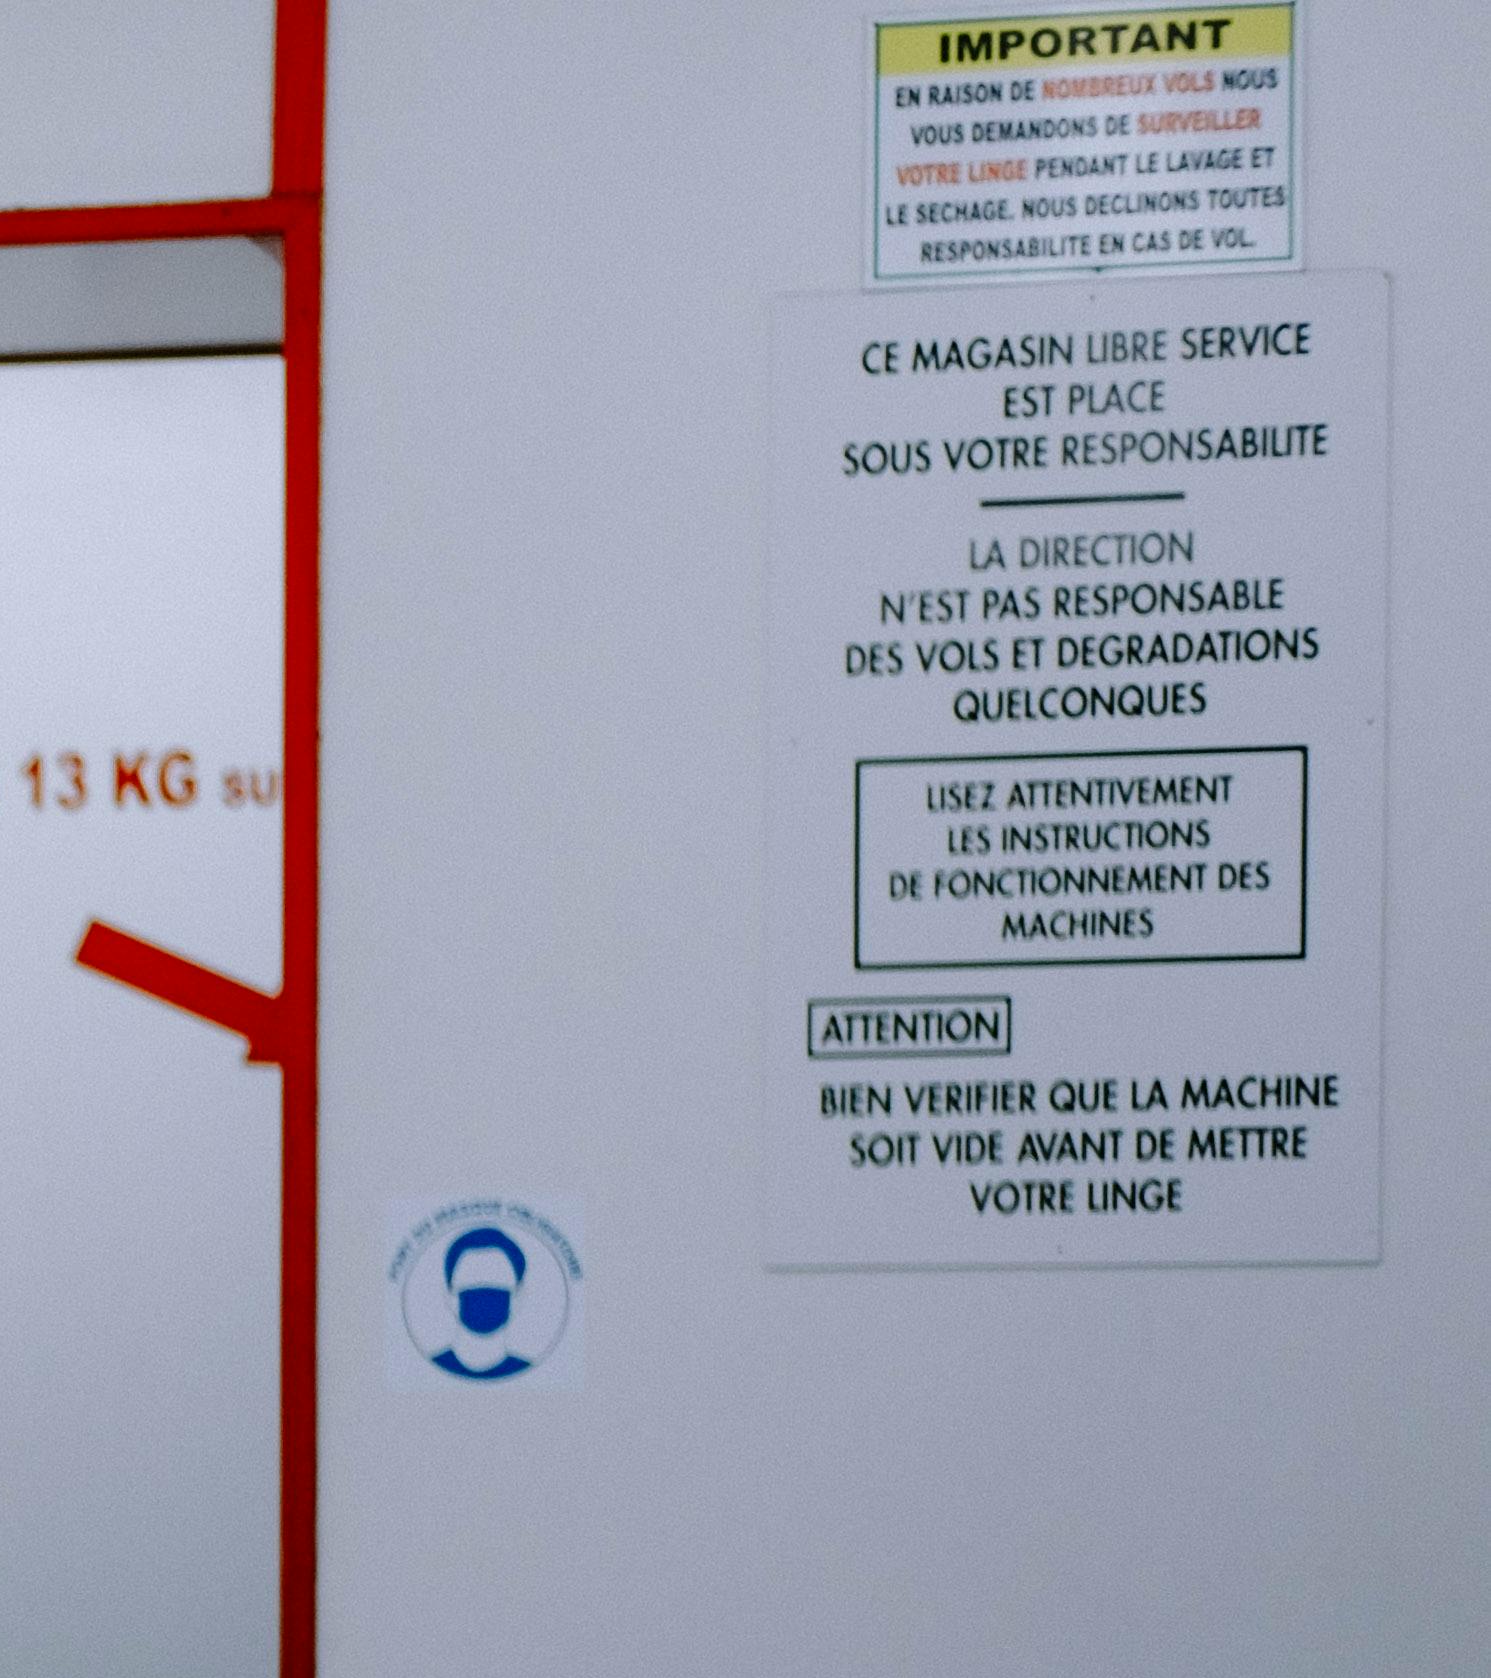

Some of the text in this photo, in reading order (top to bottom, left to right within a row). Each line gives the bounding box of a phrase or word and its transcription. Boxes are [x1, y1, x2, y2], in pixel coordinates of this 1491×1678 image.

[939, 18, 1233, 64] IMPORTANT
[895, 67, 1279, 108] EN RAISON DE NOMBREUX VOLS NOUS
[910, 107, 1261, 147] VOUS DEMANDONS DE SURVEILLER
[896, 145, 1276, 187] VOTRE LINGE PENDANT LE LAVAGE ET
[885, 203, 908, 227] LE
[1021, 196, 1077, 219] NOUS
[1085, 190, 1200, 216] DECLINONS
[1207, 184, 1290, 210] TOUTES
[920, 234, 1091, 264] RESPONSABILITE
[1098, 233, 1125, 256] EN
[1132, 230, 1171, 253] CAS
[1178, 228, 1203, 251] DE
[861, 321, 1311, 376] CE MAGASIN LIBRE SERVICE
[1002, 379, 1164, 420] EST PLACE
[843, 422, 1328, 476] SOUS VOTRE RESPONSABILITE
[969, 530, 1194, 572] LA DIRECTION
[880, 577, 1284, 624] N'EST PAS RESPONSABLE
[845, 626, 1320, 676] DES VOLS ET DEGRADATIONS
[952, 681, 1207, 723] QUELCONQUES
[22, 754, 86, 807] 13
[113, 751, 197, 807] KG
[223, 771, 280, 805] su
[926, 774, 1233, 812] LISEZ ATTENTIVEMENT
[947, 818, 1211, 855] LES INSTRUCTIONS
[889, 860, 1271, 899] DE FONCTIONNEMENT DES
[1001, 908, 1154, 939] MACHINES
[822, 1009, 1000, 1043] ATTENTION
[820, 1074, 1339, 1116] BIEN VERIFIER QUE LA MACHINE
[850, 1125, 1307, 1166] SOIT VIDE AVANT DE METTRE
[969, 1178, 1181, 1214] VOTRE LINGE
